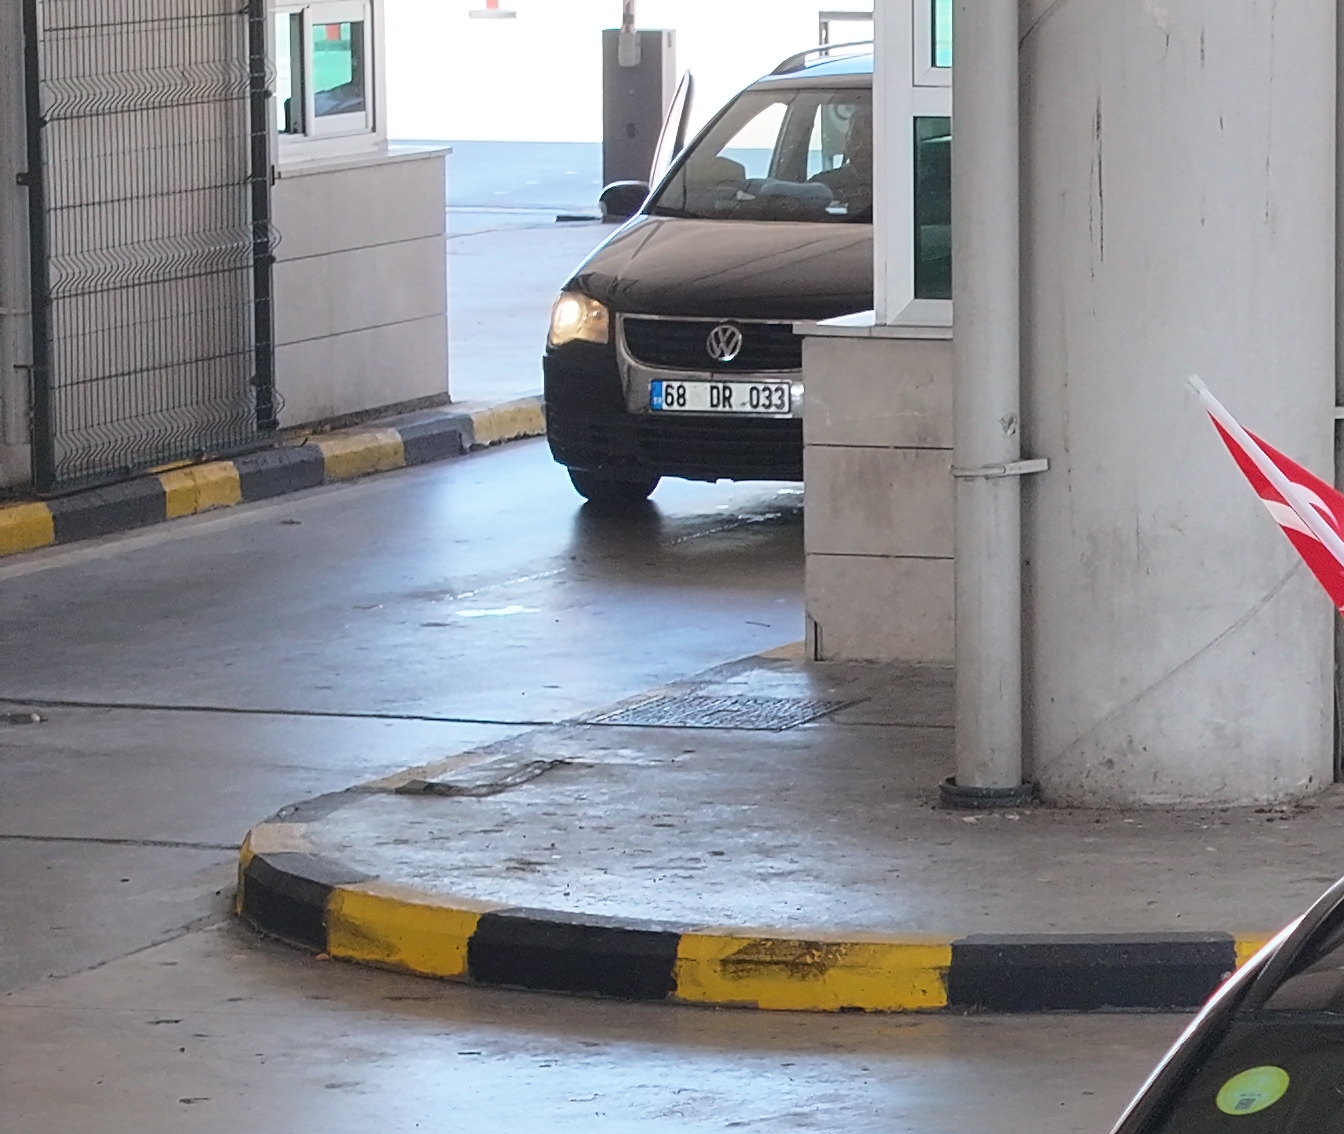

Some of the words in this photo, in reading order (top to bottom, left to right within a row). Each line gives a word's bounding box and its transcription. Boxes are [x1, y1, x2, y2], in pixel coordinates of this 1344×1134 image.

[664, 384, 687, 407] 68
[709, 385, 733, 409] DR
[749, 386, 786, 410] 033
